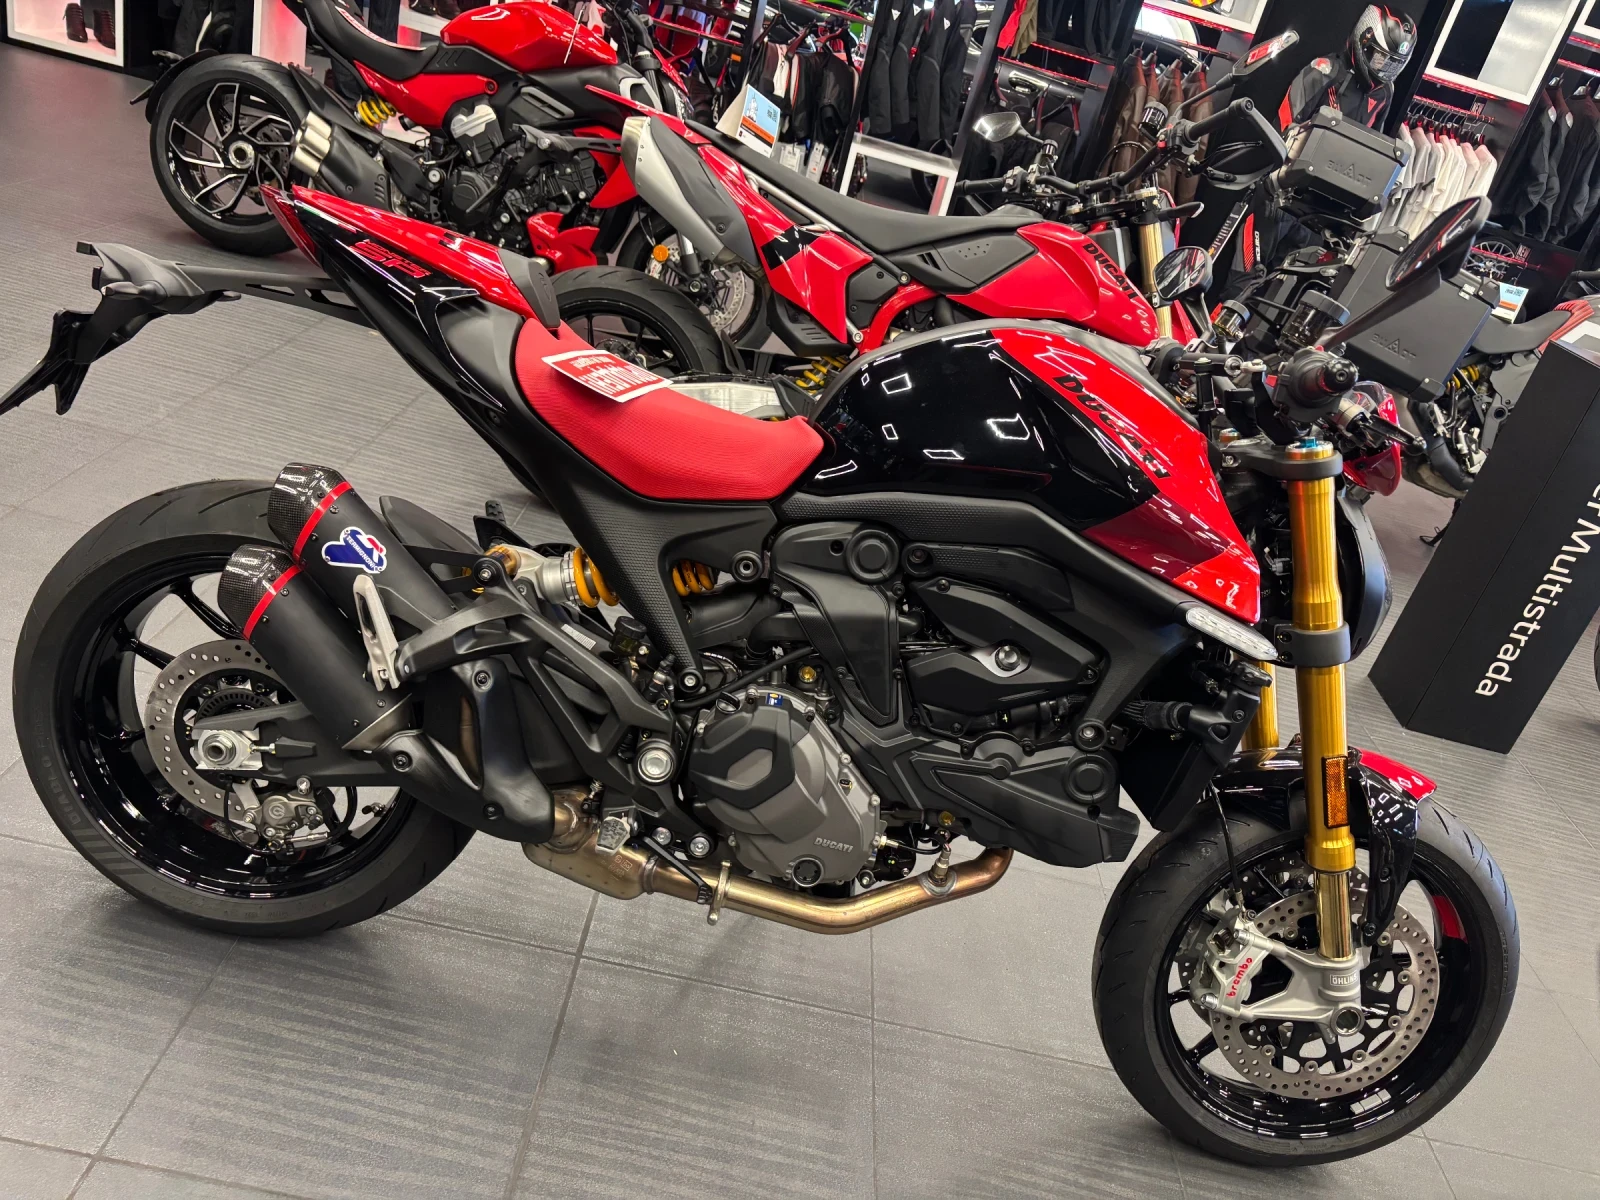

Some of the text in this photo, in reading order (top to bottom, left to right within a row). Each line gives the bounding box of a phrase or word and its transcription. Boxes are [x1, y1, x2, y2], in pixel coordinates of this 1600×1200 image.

[1082, 242, 1139, 300] DUCATI
[1052, 374, 1171, 478] DUCATI
[1475, 518, 1600, 697] Multistrada
[814, 837, 854, 853] DUCATI
[1226, 957, 1253, 998] brembo
